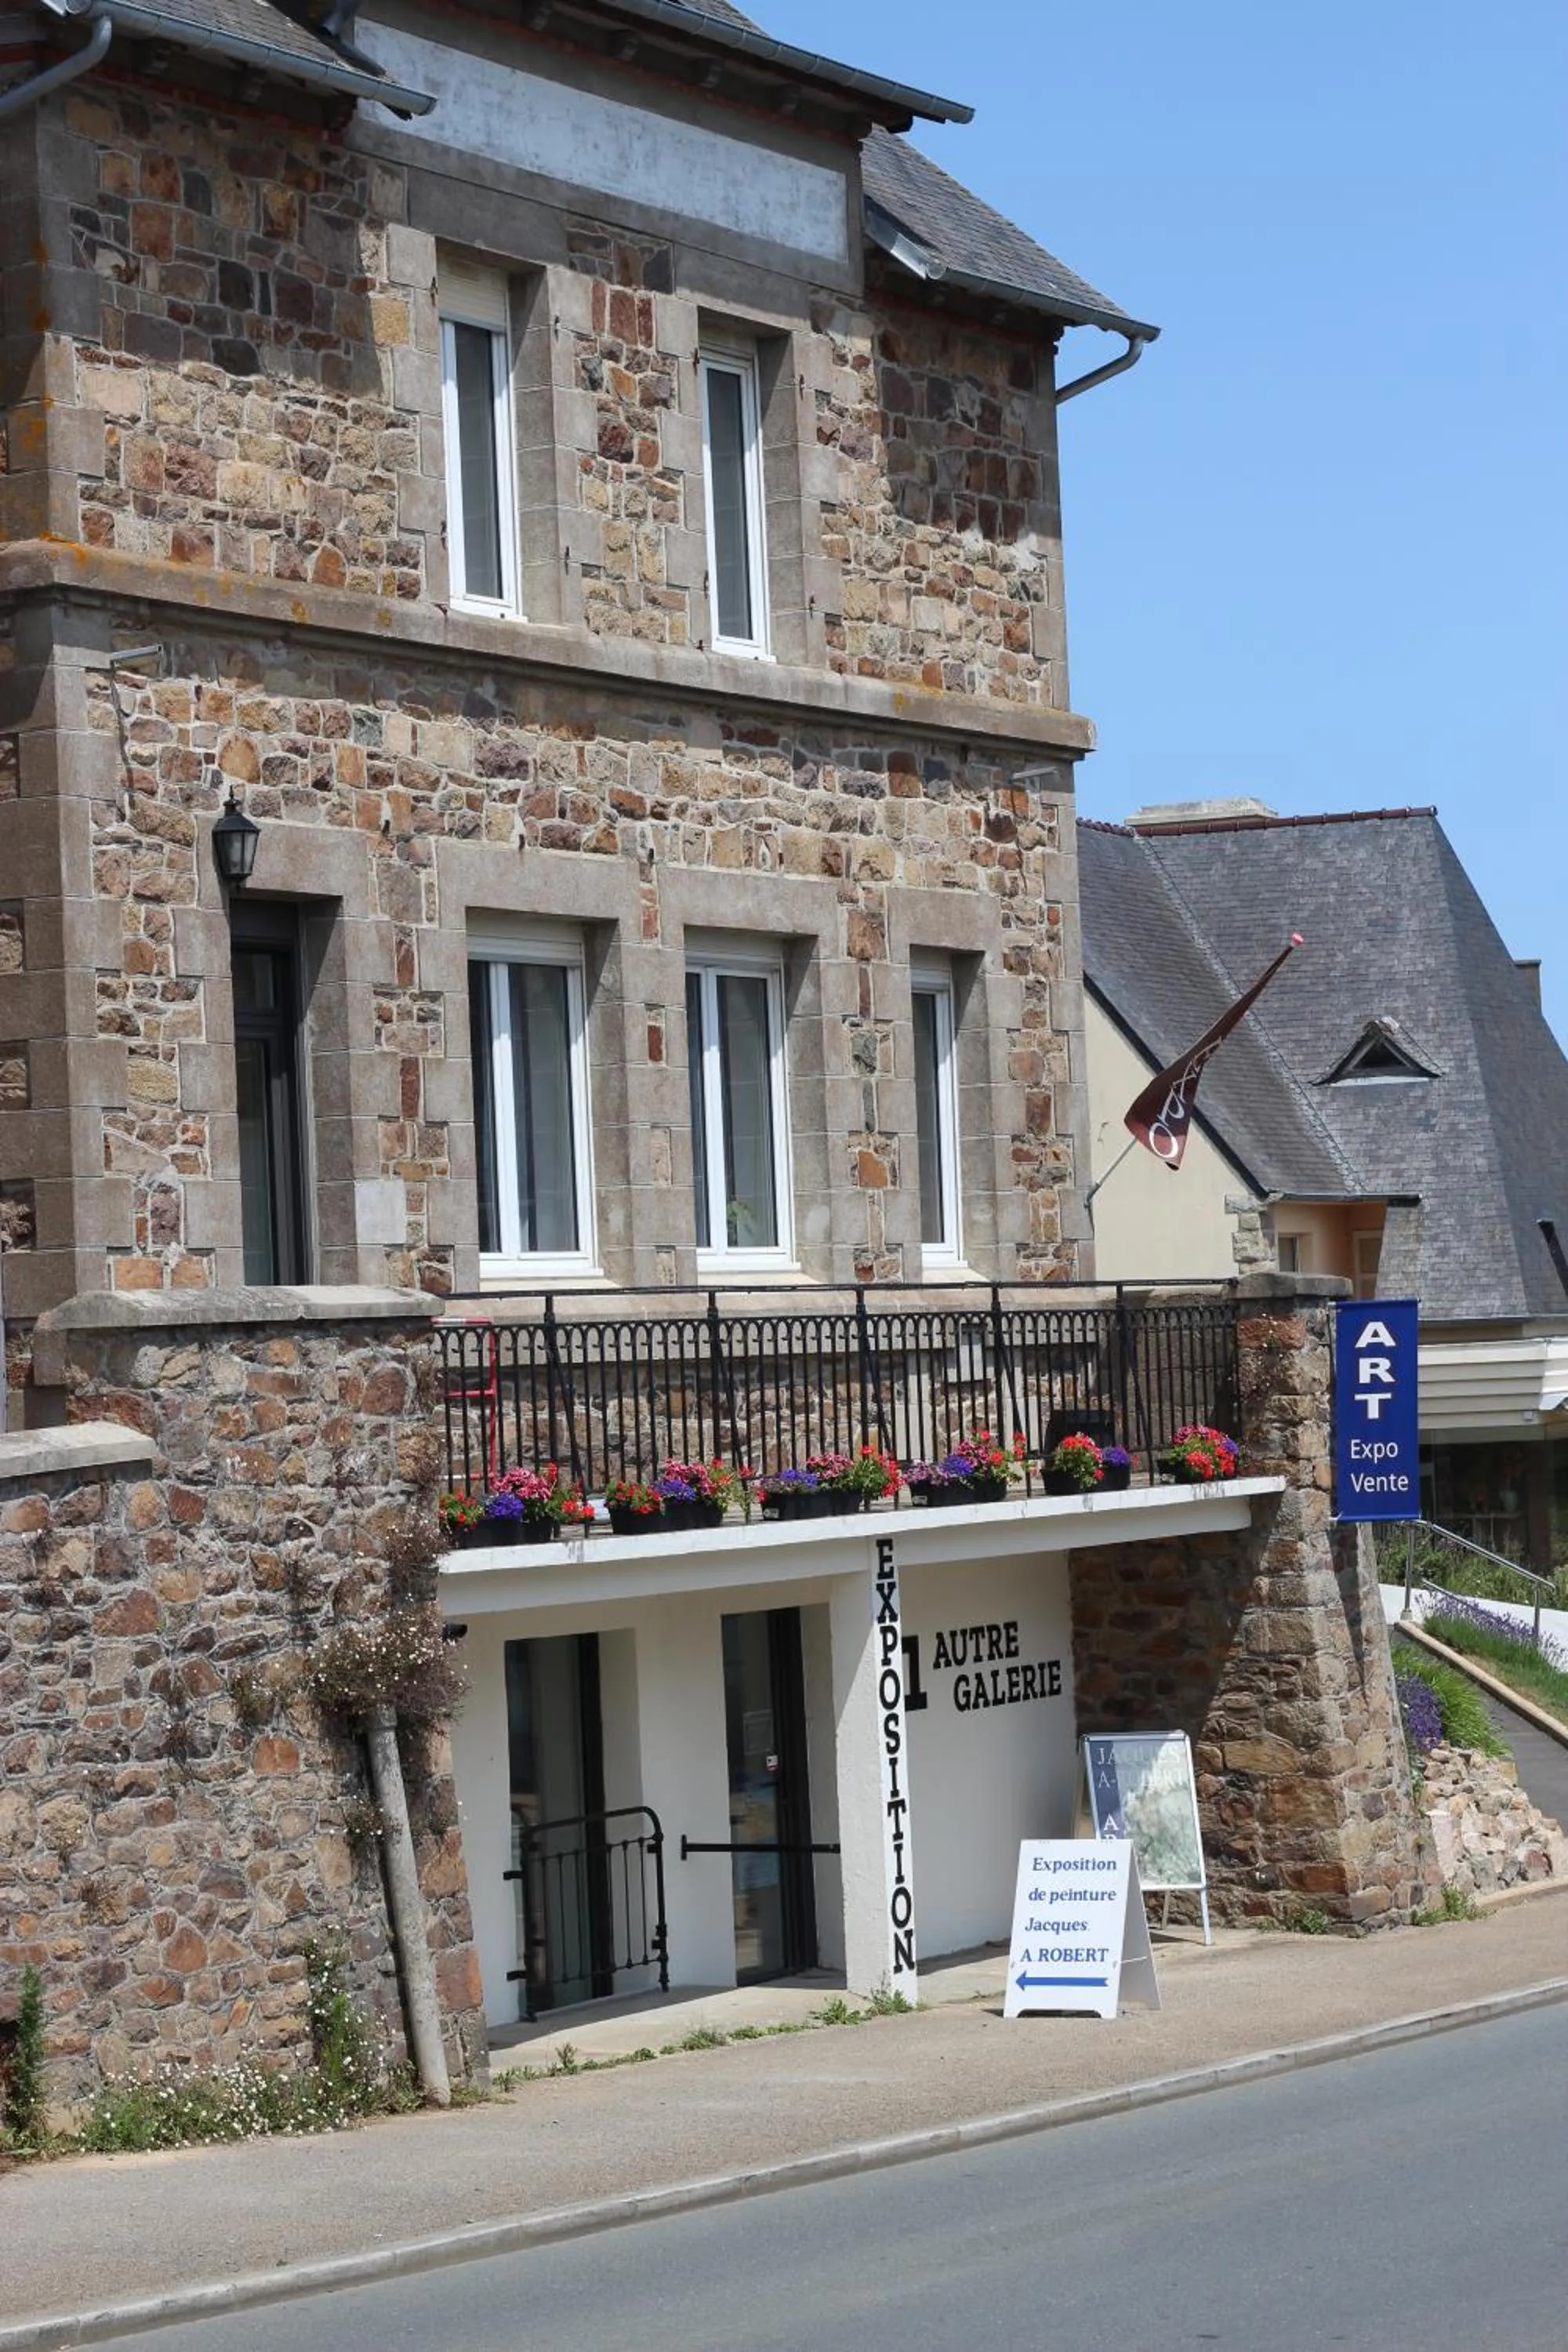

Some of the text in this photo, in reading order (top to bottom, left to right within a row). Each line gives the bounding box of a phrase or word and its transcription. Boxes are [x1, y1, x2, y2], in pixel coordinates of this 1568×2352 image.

[1355, 1321, 1396, 1419] ART
[1351, 1439, 1398, 1464] Expo
[1350, 1473, 1409, 1493] Vente
[933, 1621, 1019, 1670] AUTRE
[953, 1660, 1062, 1712] GALERIE
[877, 1539, 915, 1973] EXPOSITION
[1033, 1857, 1117, 1874] Exposition
[1029, 1888, 1116, 1904] de peinture
[1025, 1918, 1088, 1935] Jacques
[1020, 1948, 1109, 1962] A ROBERT
